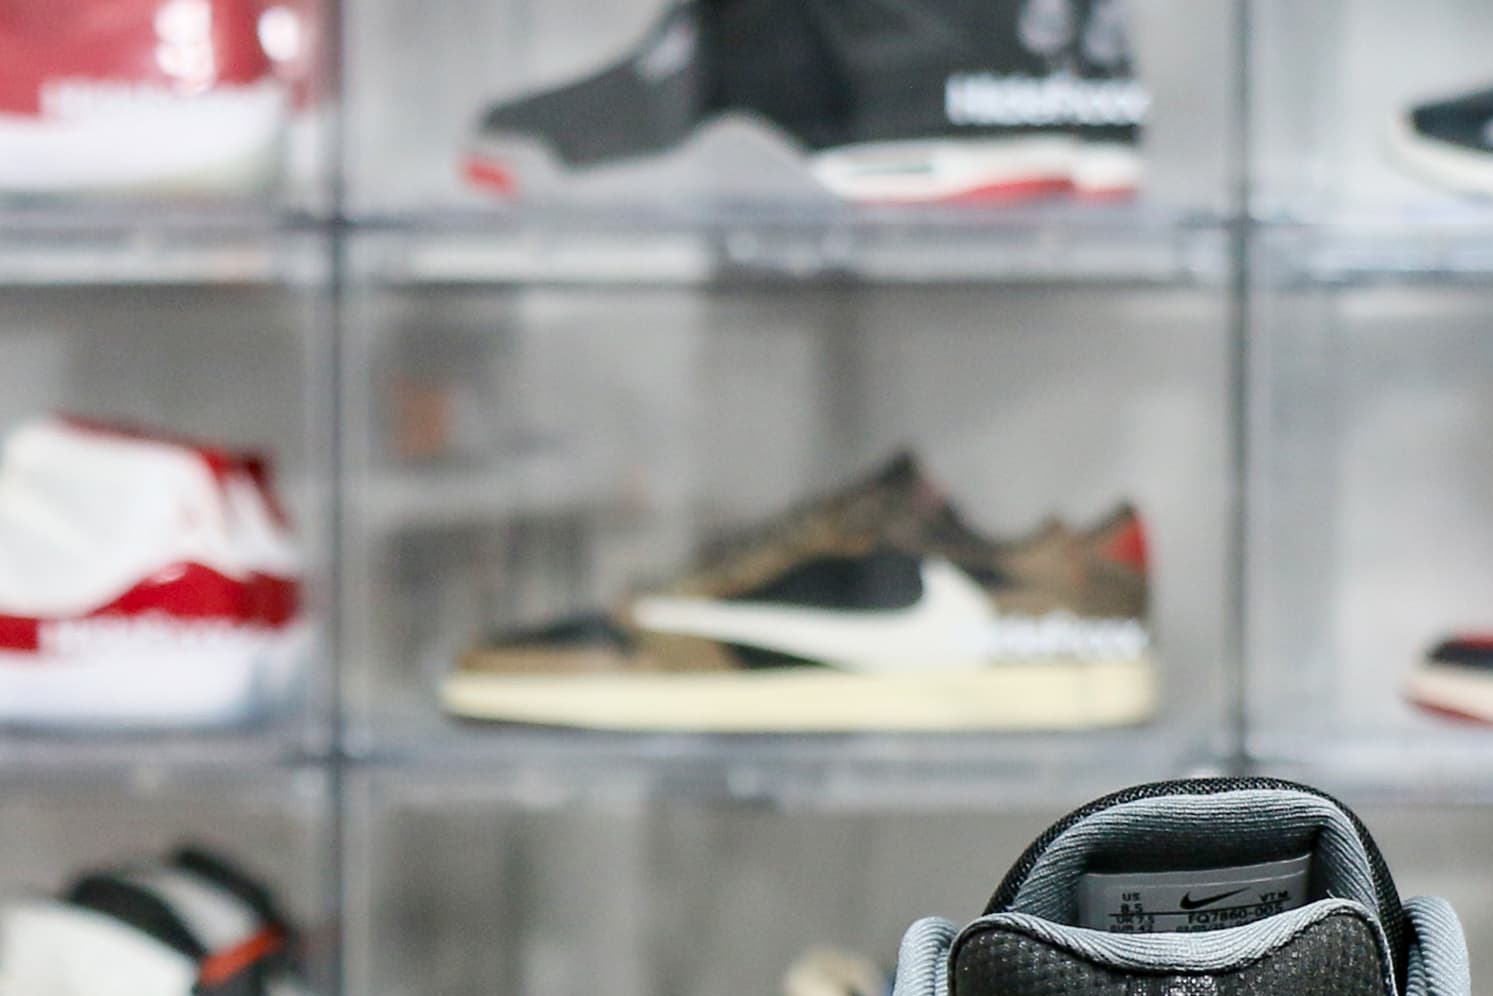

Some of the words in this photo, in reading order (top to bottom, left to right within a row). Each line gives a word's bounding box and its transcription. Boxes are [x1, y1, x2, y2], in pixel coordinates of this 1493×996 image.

[1122, 892, 1141, 901] US
[1259, 890, 1289, 903] VTM
[1120, 903, 1144, 915] 8.5
[1188, 903, 1284, 924] FQ7860-005
